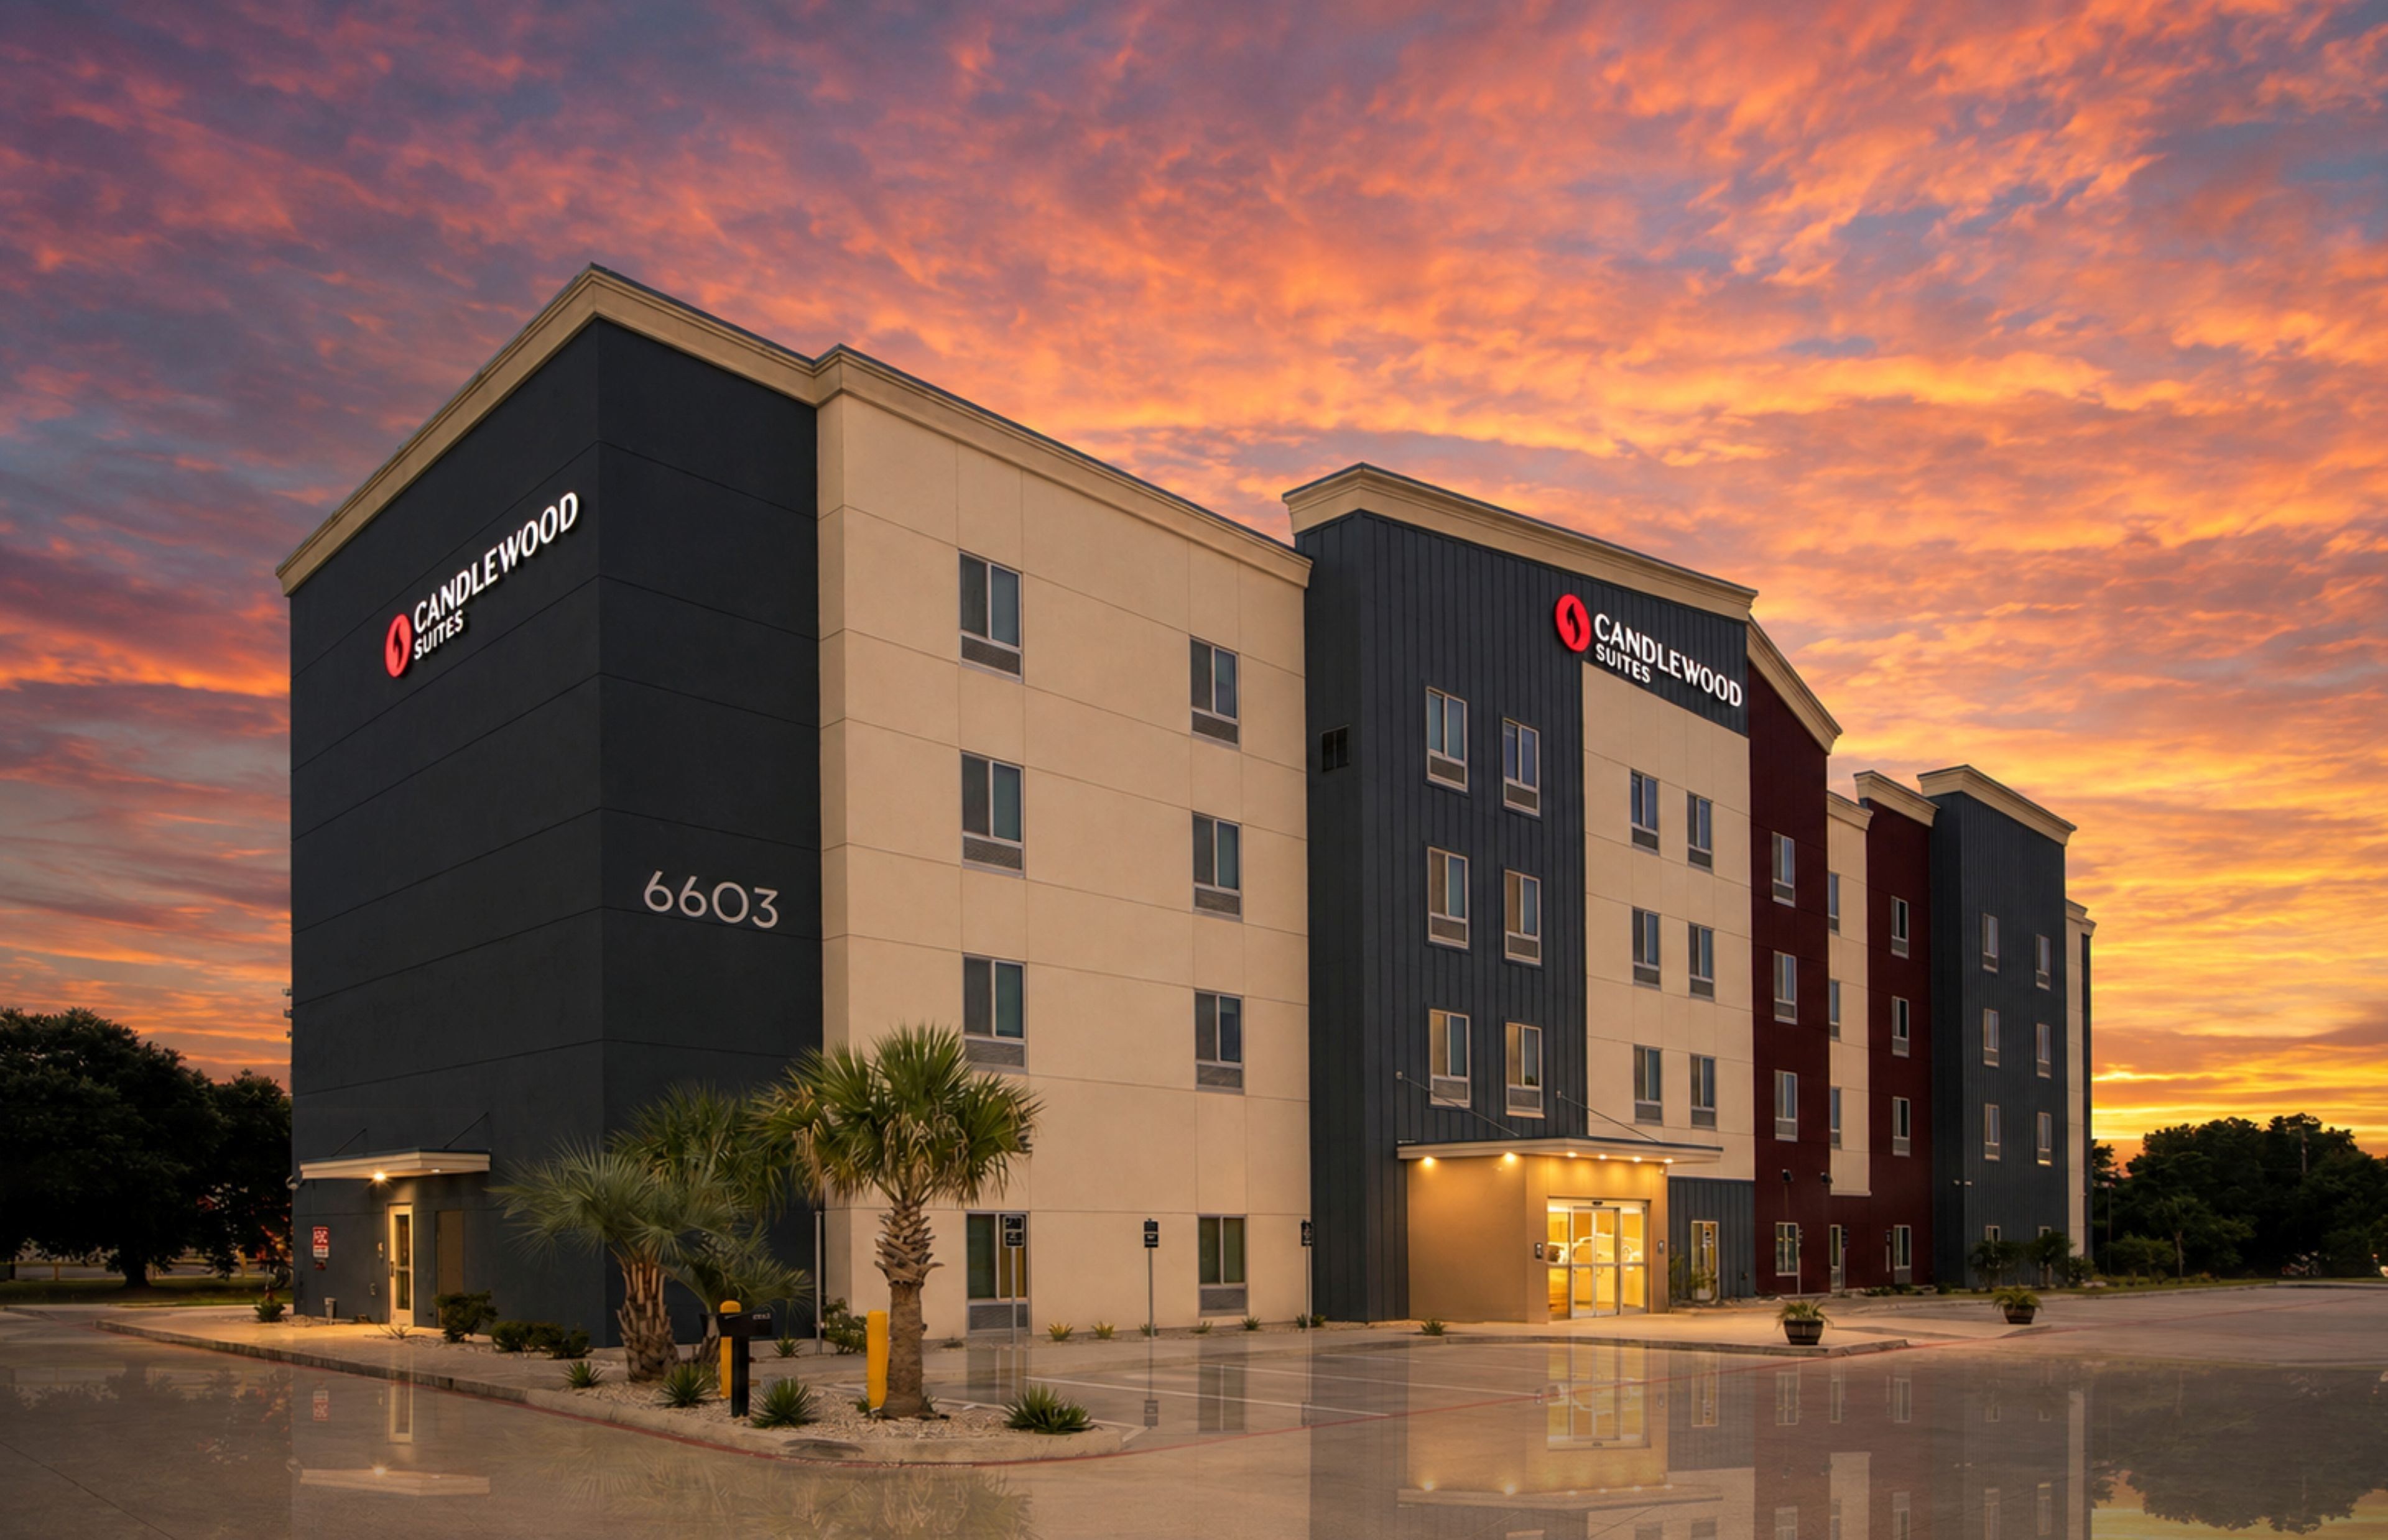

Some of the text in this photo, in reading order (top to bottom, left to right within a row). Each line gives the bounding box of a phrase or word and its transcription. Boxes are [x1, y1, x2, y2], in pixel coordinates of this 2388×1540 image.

[414, 492, 578, 634] CANDLEWOOD
[414, 609, 463, 660] SUITES
[1594, 613, 1742, 707] CANDLEWOOD
[1595, 643, 1650, 683] SUITES
[644, 870, 779, 928] 6603
